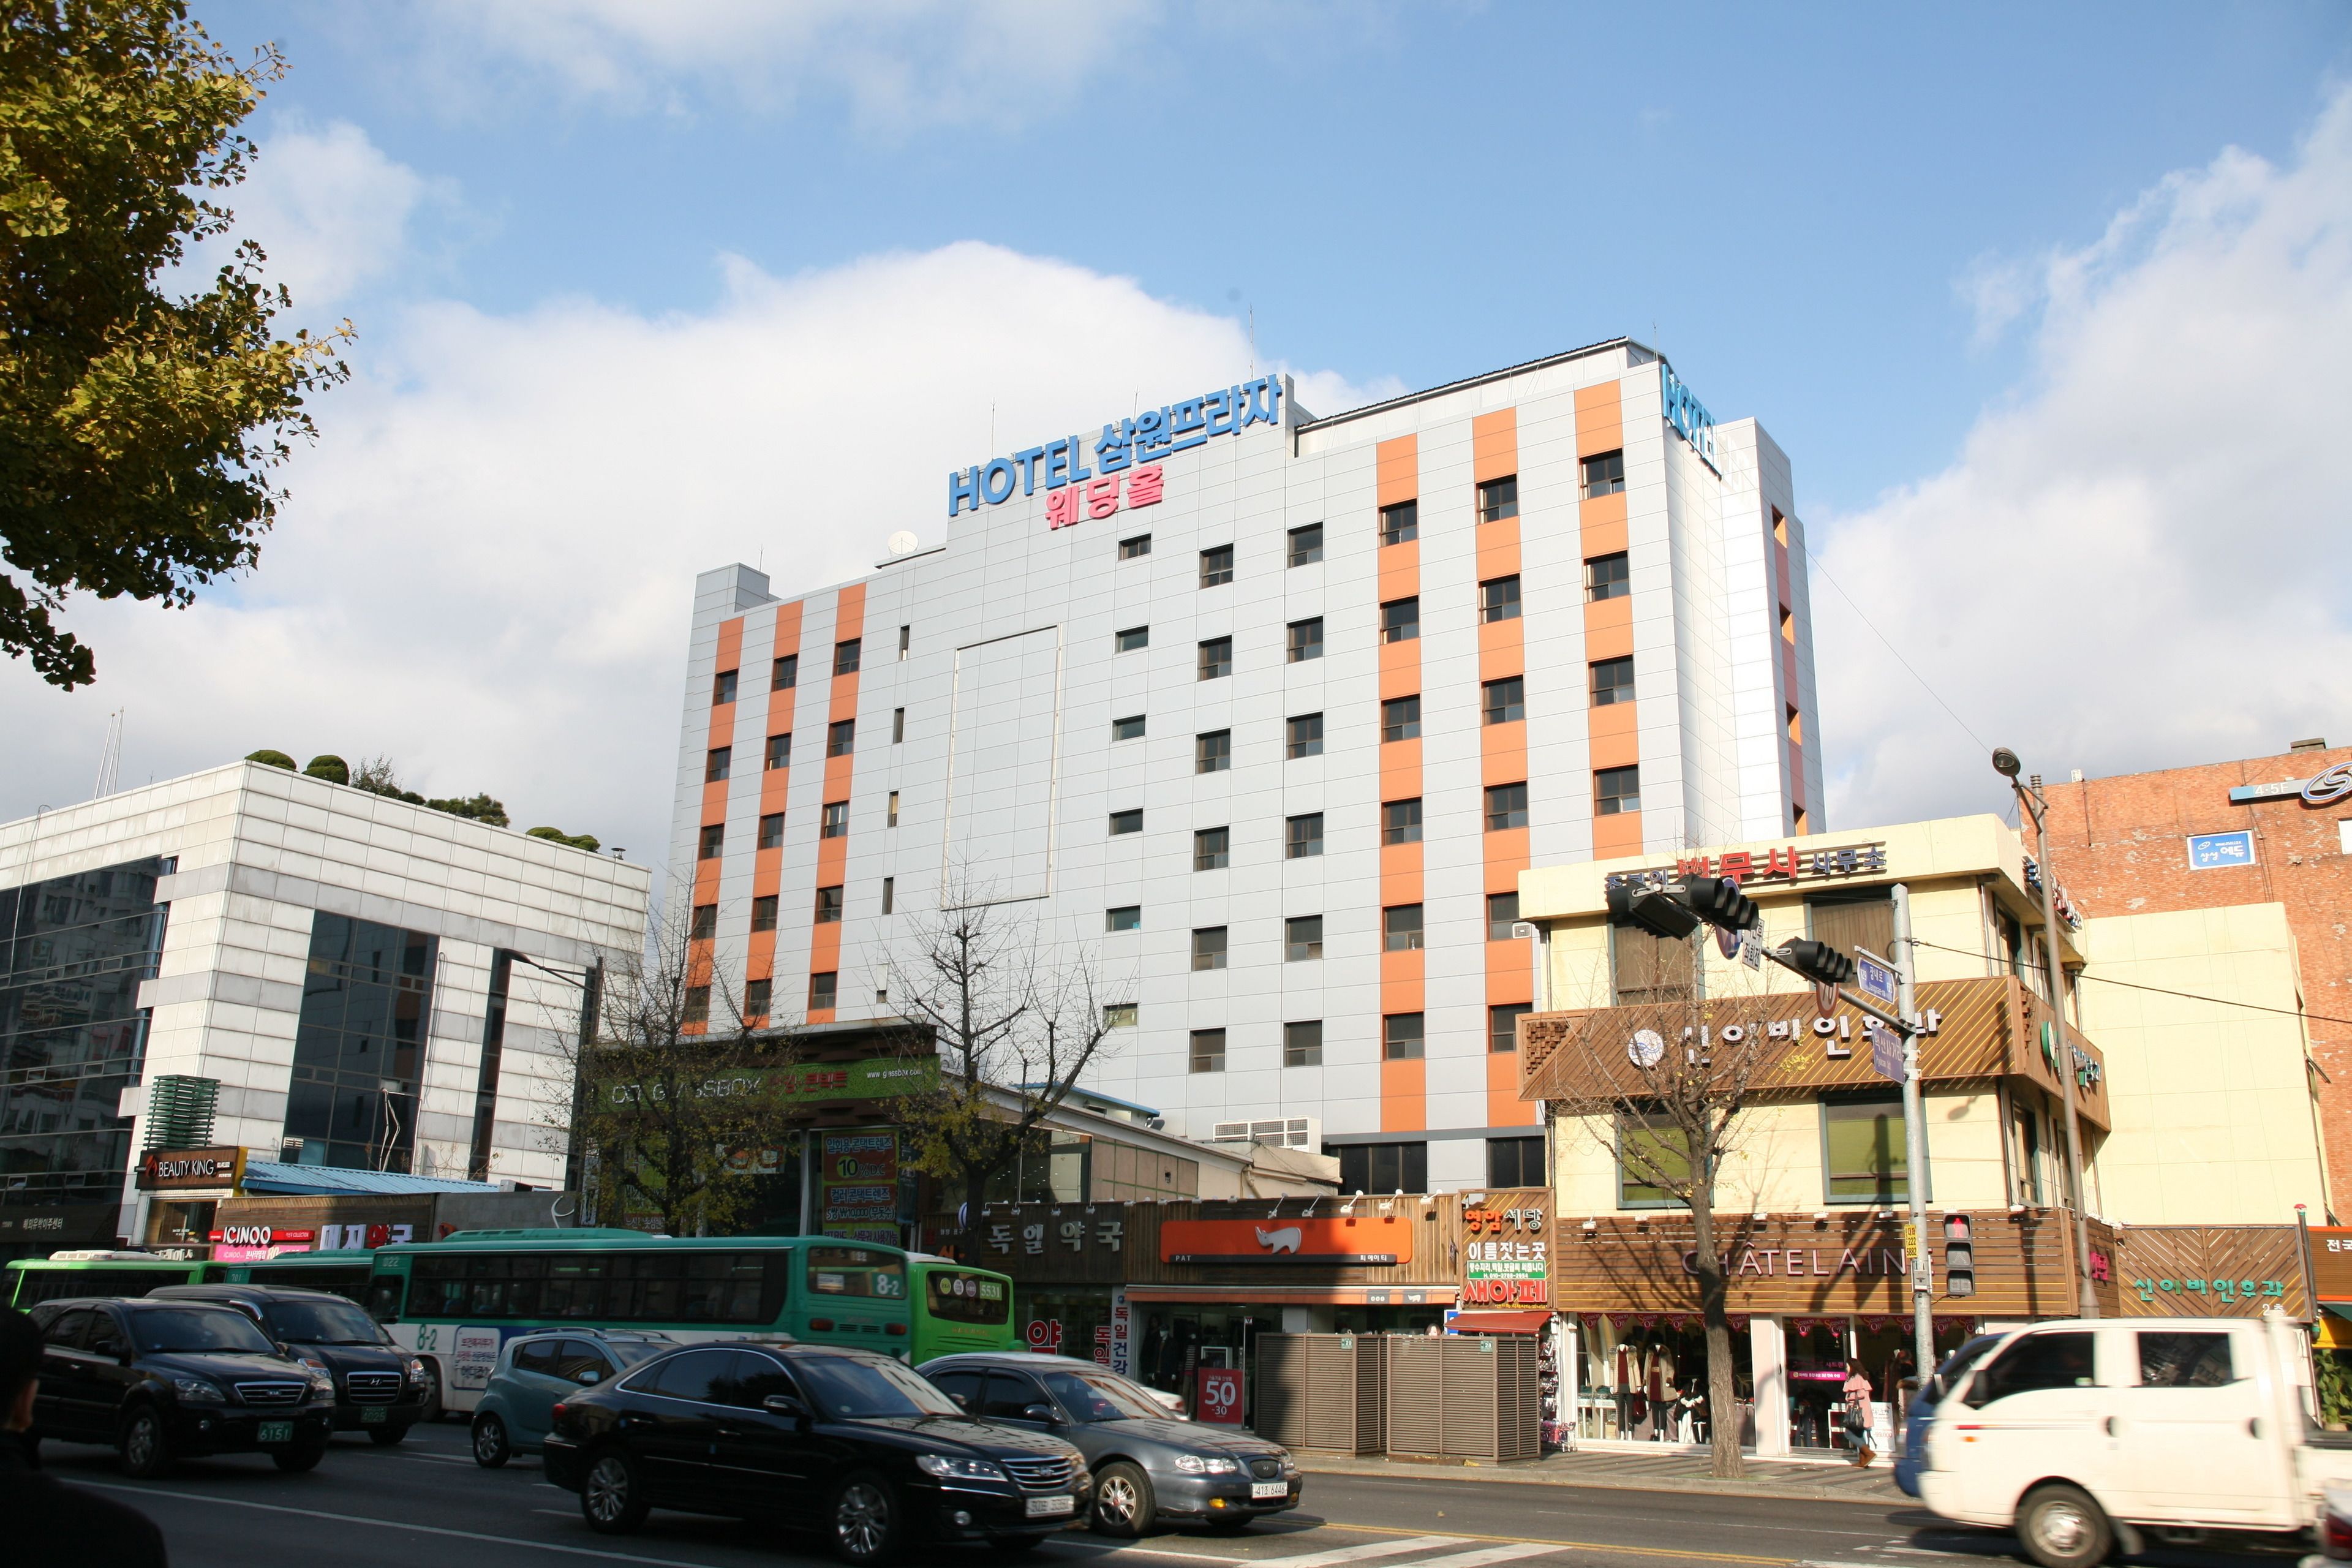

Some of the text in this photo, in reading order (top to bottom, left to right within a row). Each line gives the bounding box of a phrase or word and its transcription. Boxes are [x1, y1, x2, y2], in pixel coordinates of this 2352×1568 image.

[949, 374, 1283, 516] HOTEL 삼원프라자
[1045, 464, 1164, 530] 웨딩홀
[1810, 846, 1887, 873] 사무소
[159, 1160, 190, 1177] BEAUTY
[191, 1159, 214, 1175] KING
[222, 1226, 271, 1245] ICINOO
[1682, 1242, 1933, 1276] CHÂTELAIN
[876, 1274, 899, 1295] 8-2
[981, 1284, 1000, 1298] 5531
[2133, 1278, 2284, 1303] 신이비인후과
[417, 1323, 437, 1351] 8-2
[1205, 1381, 1236, 1406] 50
[260, 1428, 289, 1441] 6151
[1271, 1484, 1285, 1495] 6446
